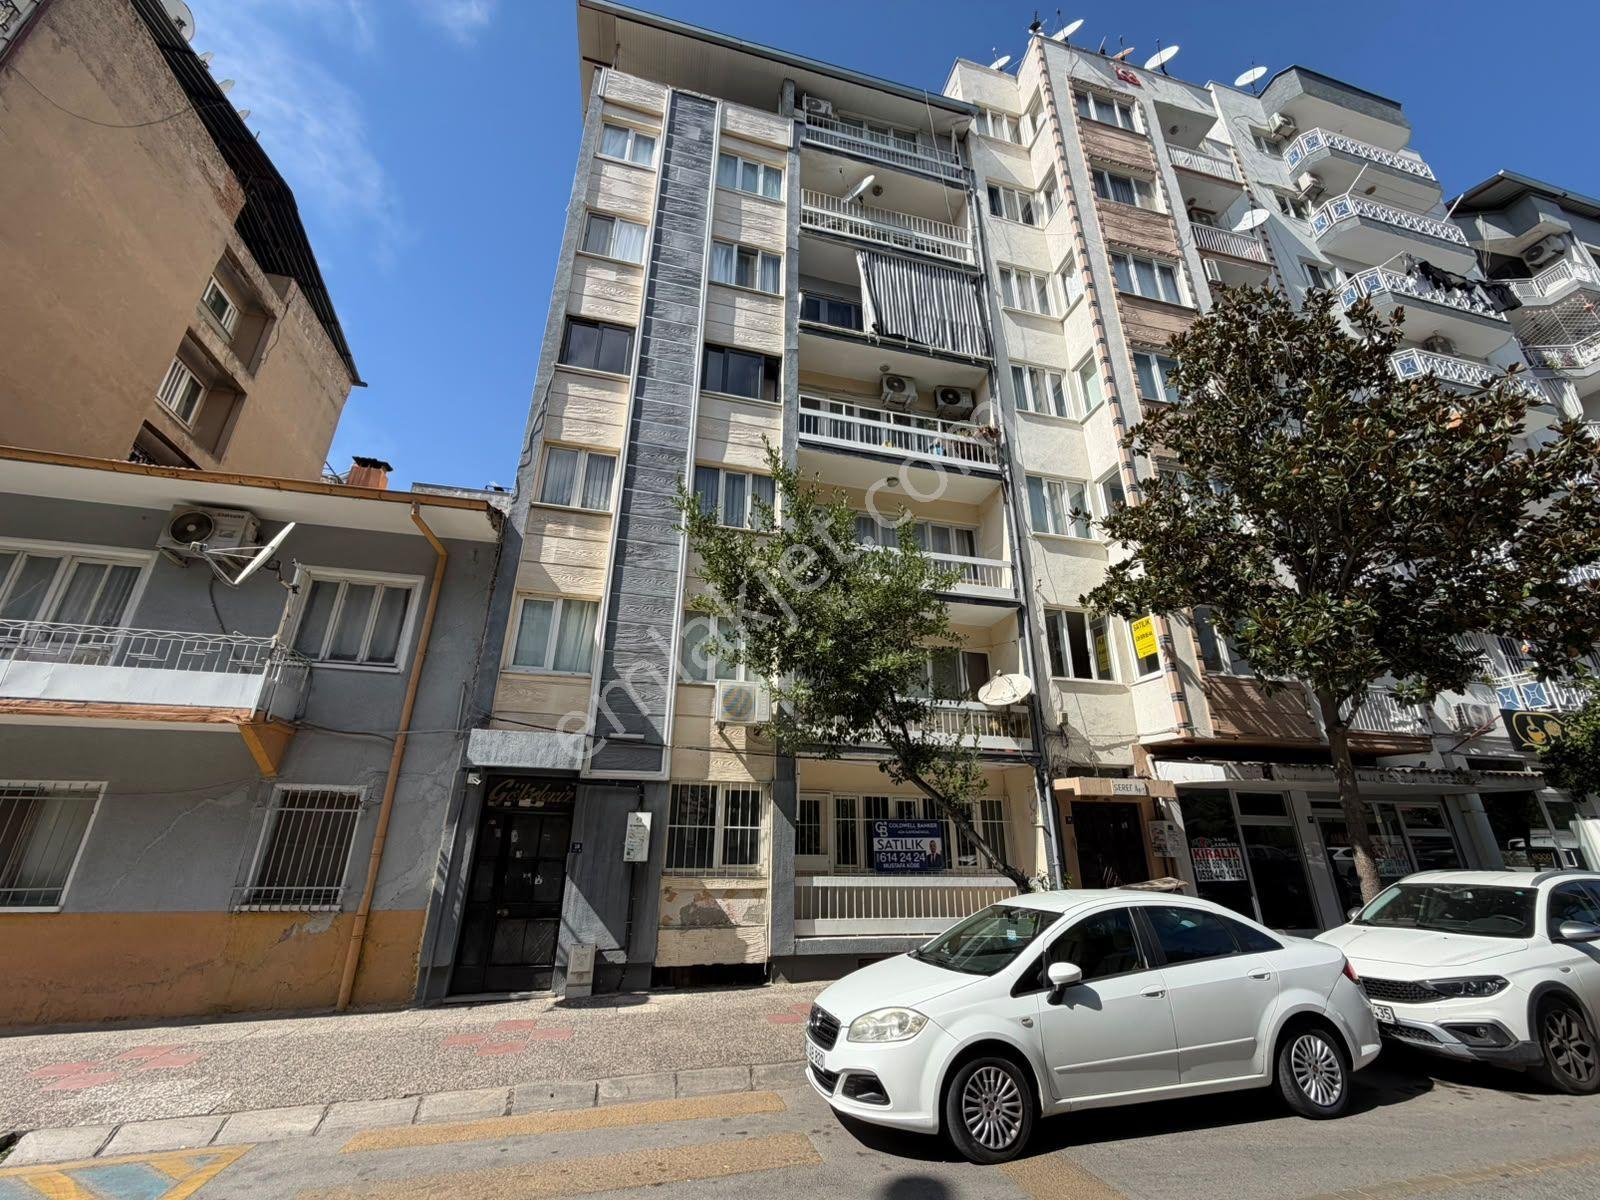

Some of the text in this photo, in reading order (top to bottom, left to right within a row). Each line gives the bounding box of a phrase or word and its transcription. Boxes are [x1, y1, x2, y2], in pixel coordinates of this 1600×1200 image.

[877, 839, 924, 850] SATILIK
[880, 852, 898, 863] 614
[900, 852, 912, 862] 24
[913, 852, 926, 862] 24
